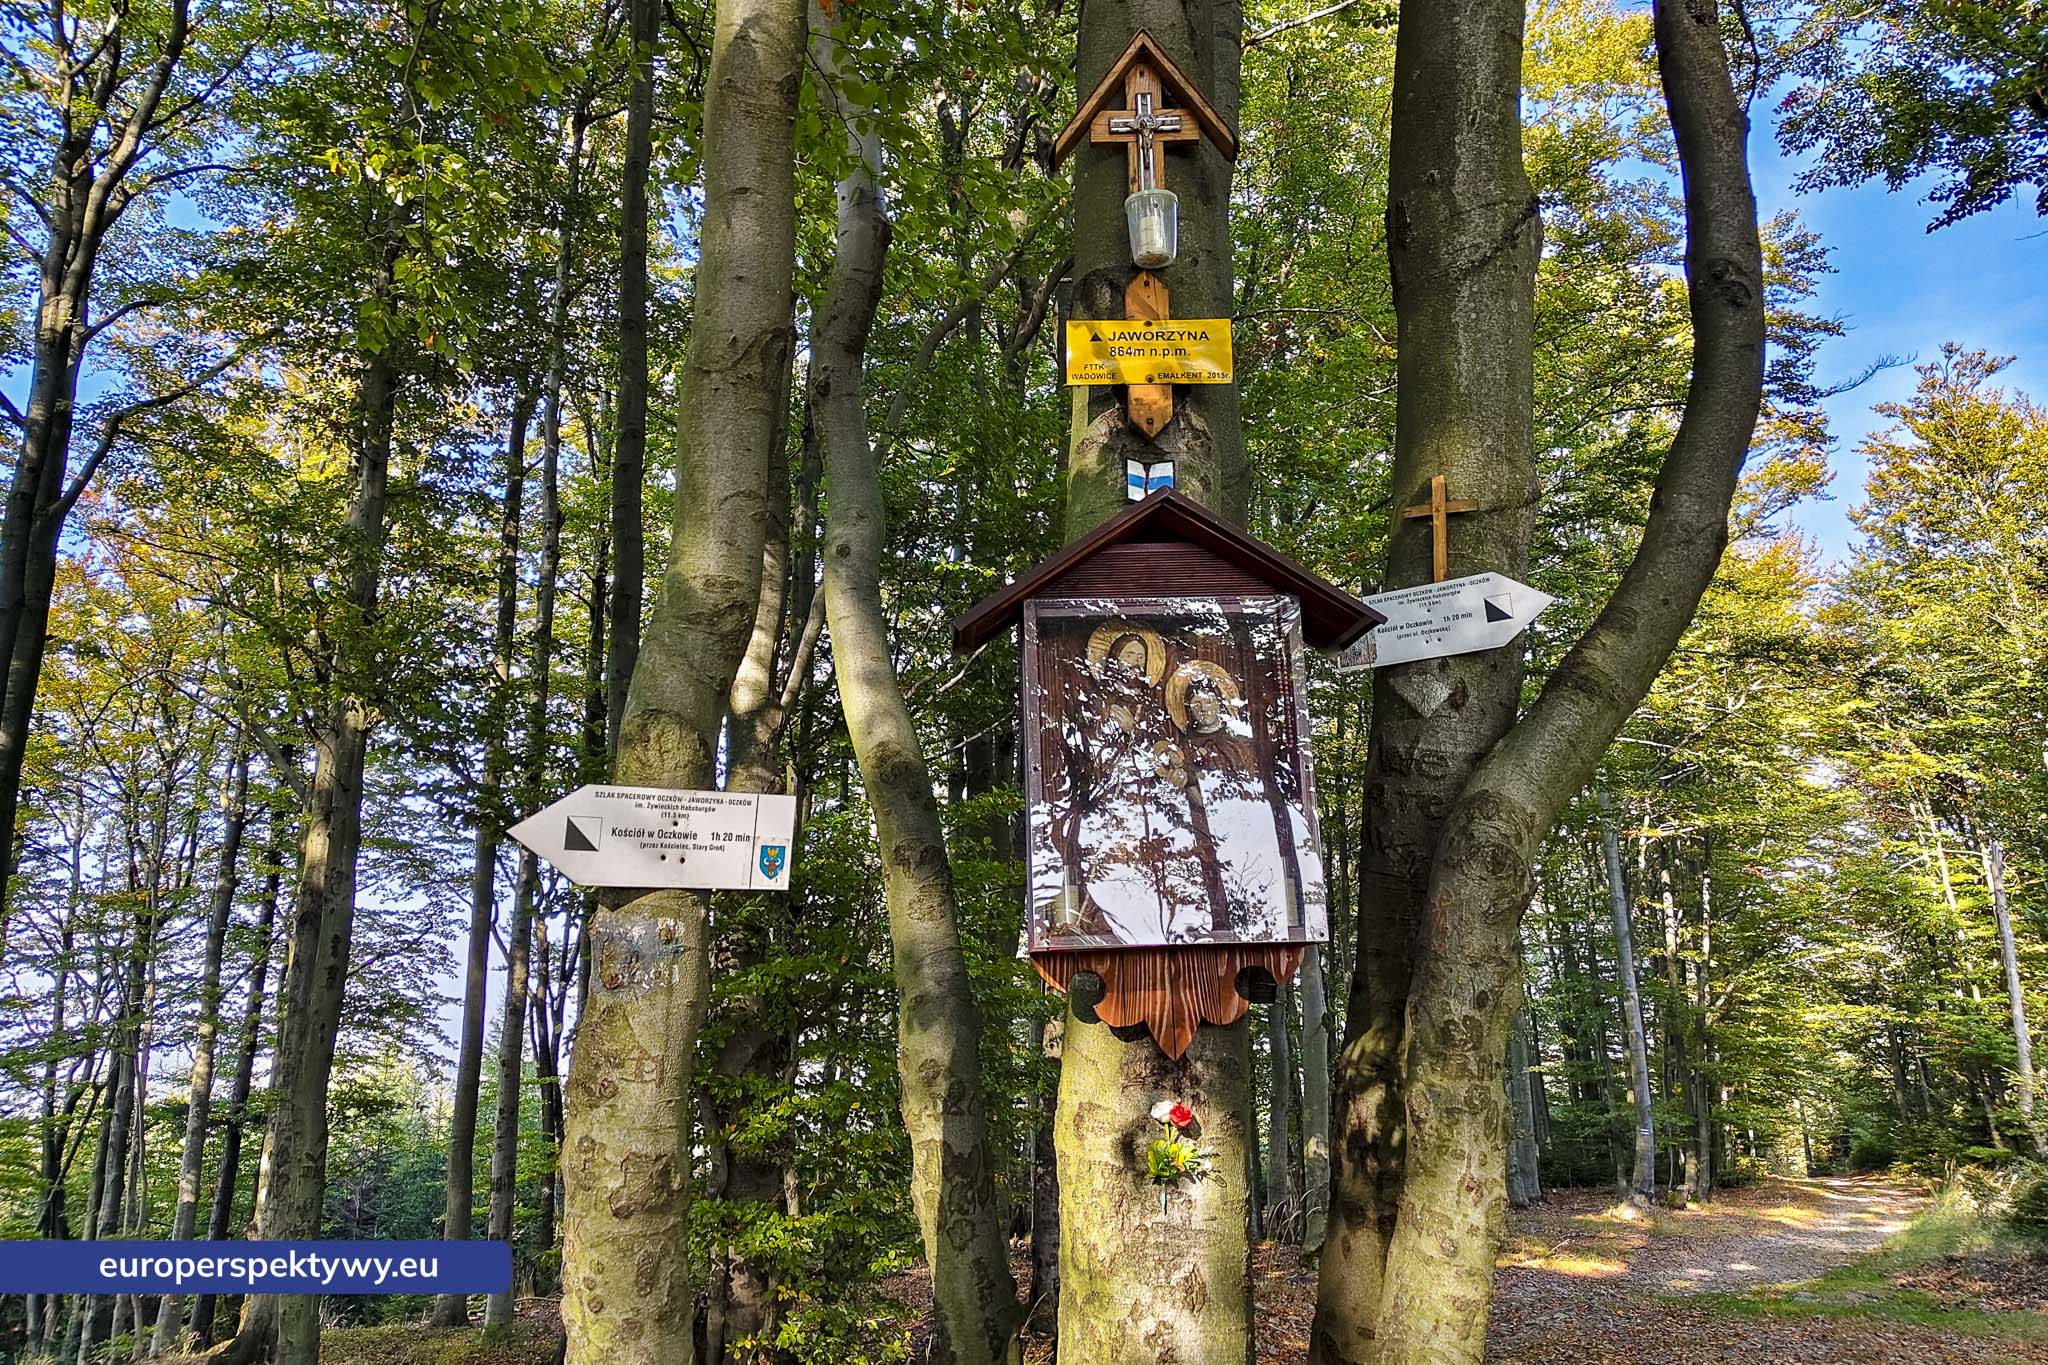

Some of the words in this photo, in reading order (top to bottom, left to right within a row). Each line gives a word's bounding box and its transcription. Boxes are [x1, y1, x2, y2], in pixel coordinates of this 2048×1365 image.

[1108, 330, 1210, 342] JAWORZYNA
[1110, 346, 1144, 356] 864m
[1150, 348, 1191, 359] n.p.m.
[1377, 625, 1398, 634] Kościół
[1406, 619, 1432, 629] Oczkowie
[617, 792, 656, 800] SPACEROWY
[680, 805, 716, 813] Habsburgów
[611, 826, 645, 838] Kościół
[657, 829, 698, 840] Oczkowie
[711, 832, 720, 840] 1h
[723, 832, 733, 841] 20
[735, 833, 750, 842] min
